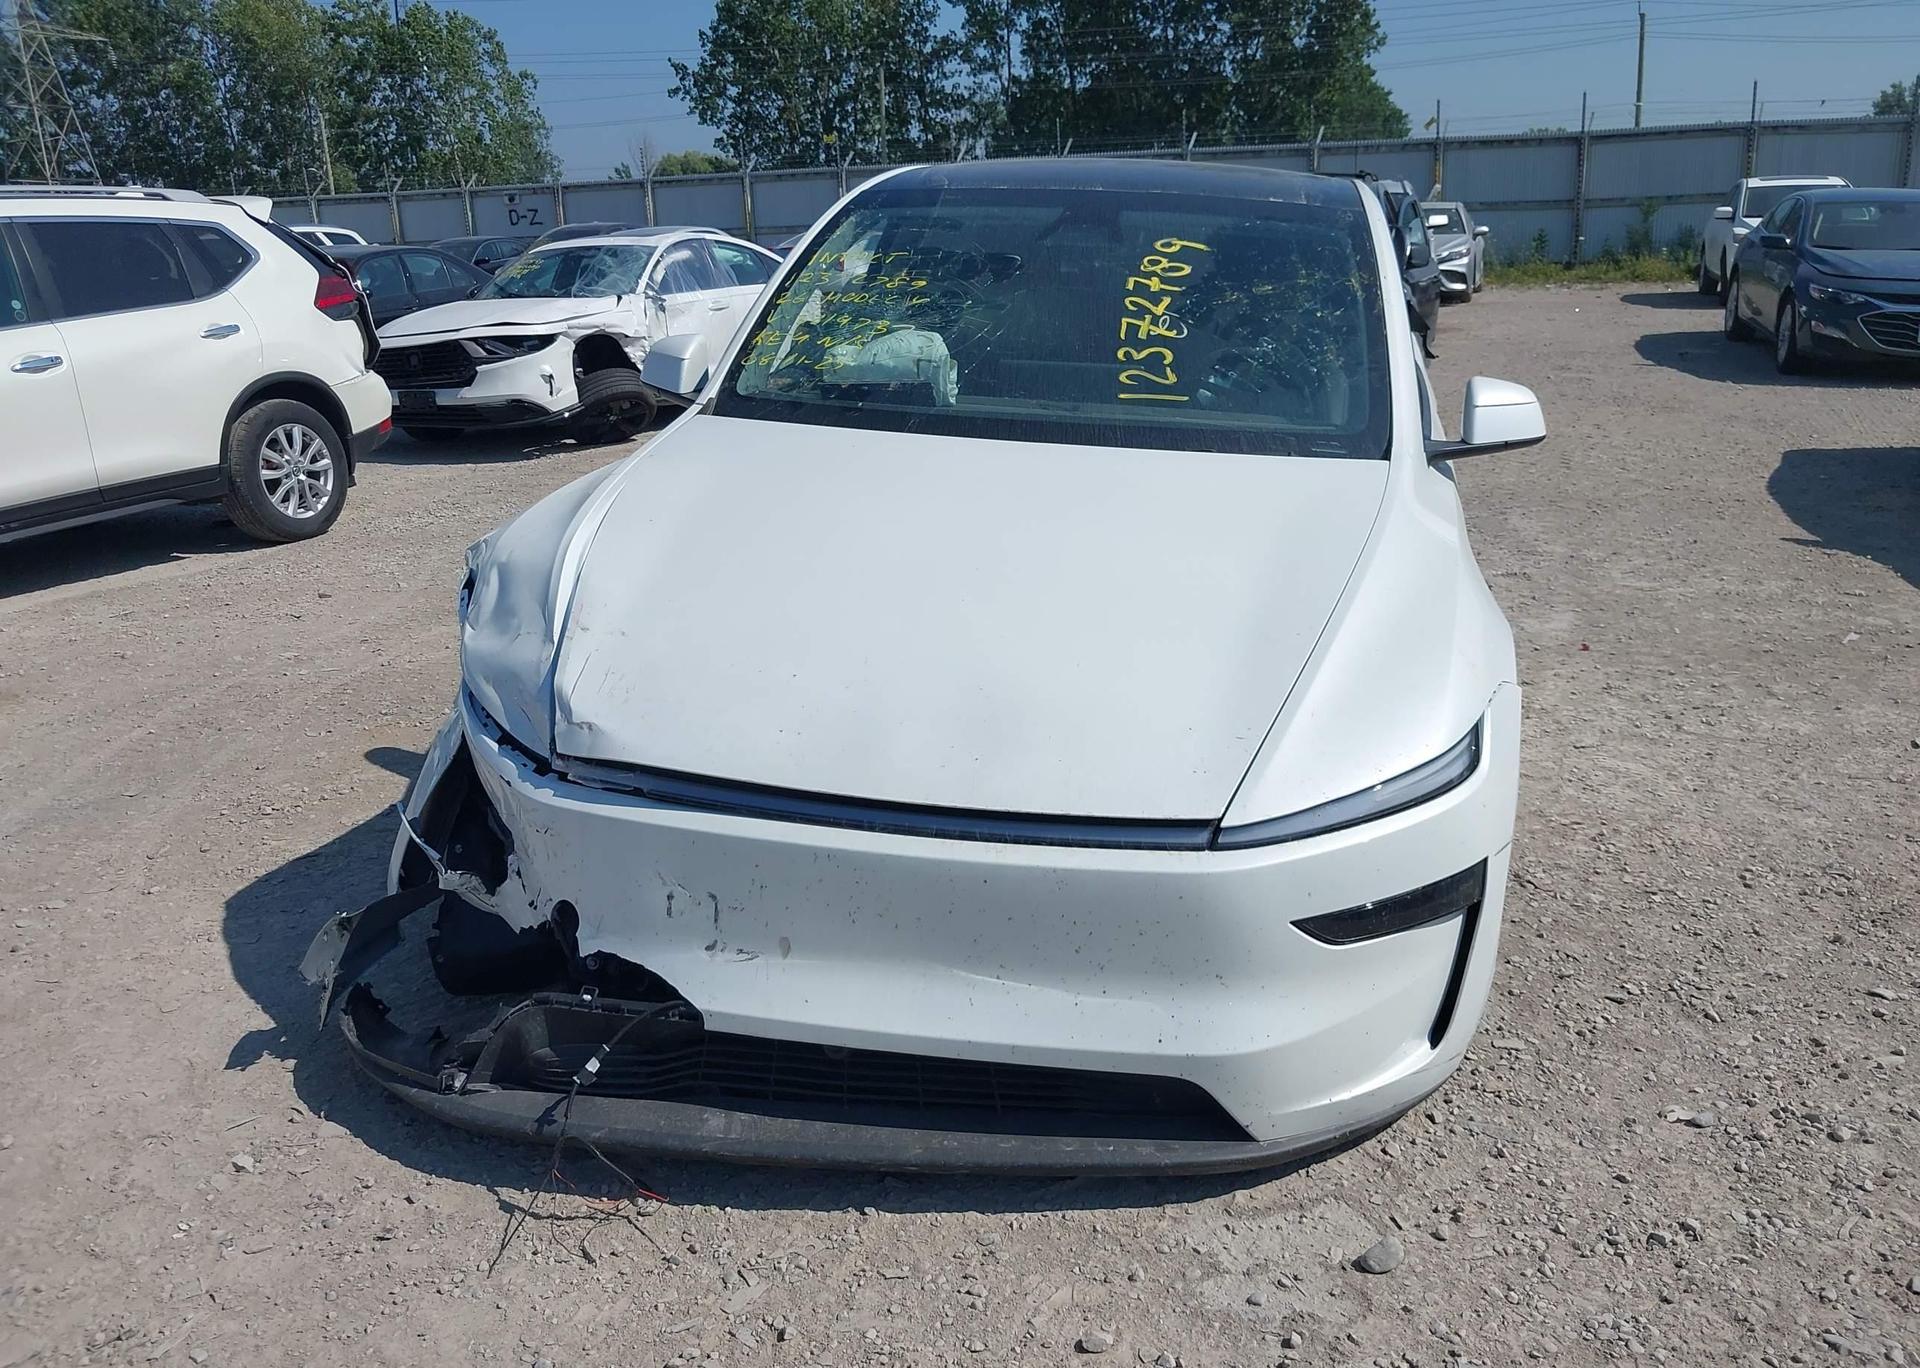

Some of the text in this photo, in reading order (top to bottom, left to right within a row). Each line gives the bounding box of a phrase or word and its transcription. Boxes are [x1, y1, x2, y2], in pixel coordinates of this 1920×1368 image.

[508, 208, 544, 226] D-Z
[785, 272, 928, 290] 1232789
[1117, 238, 1212, 401] 12372789
